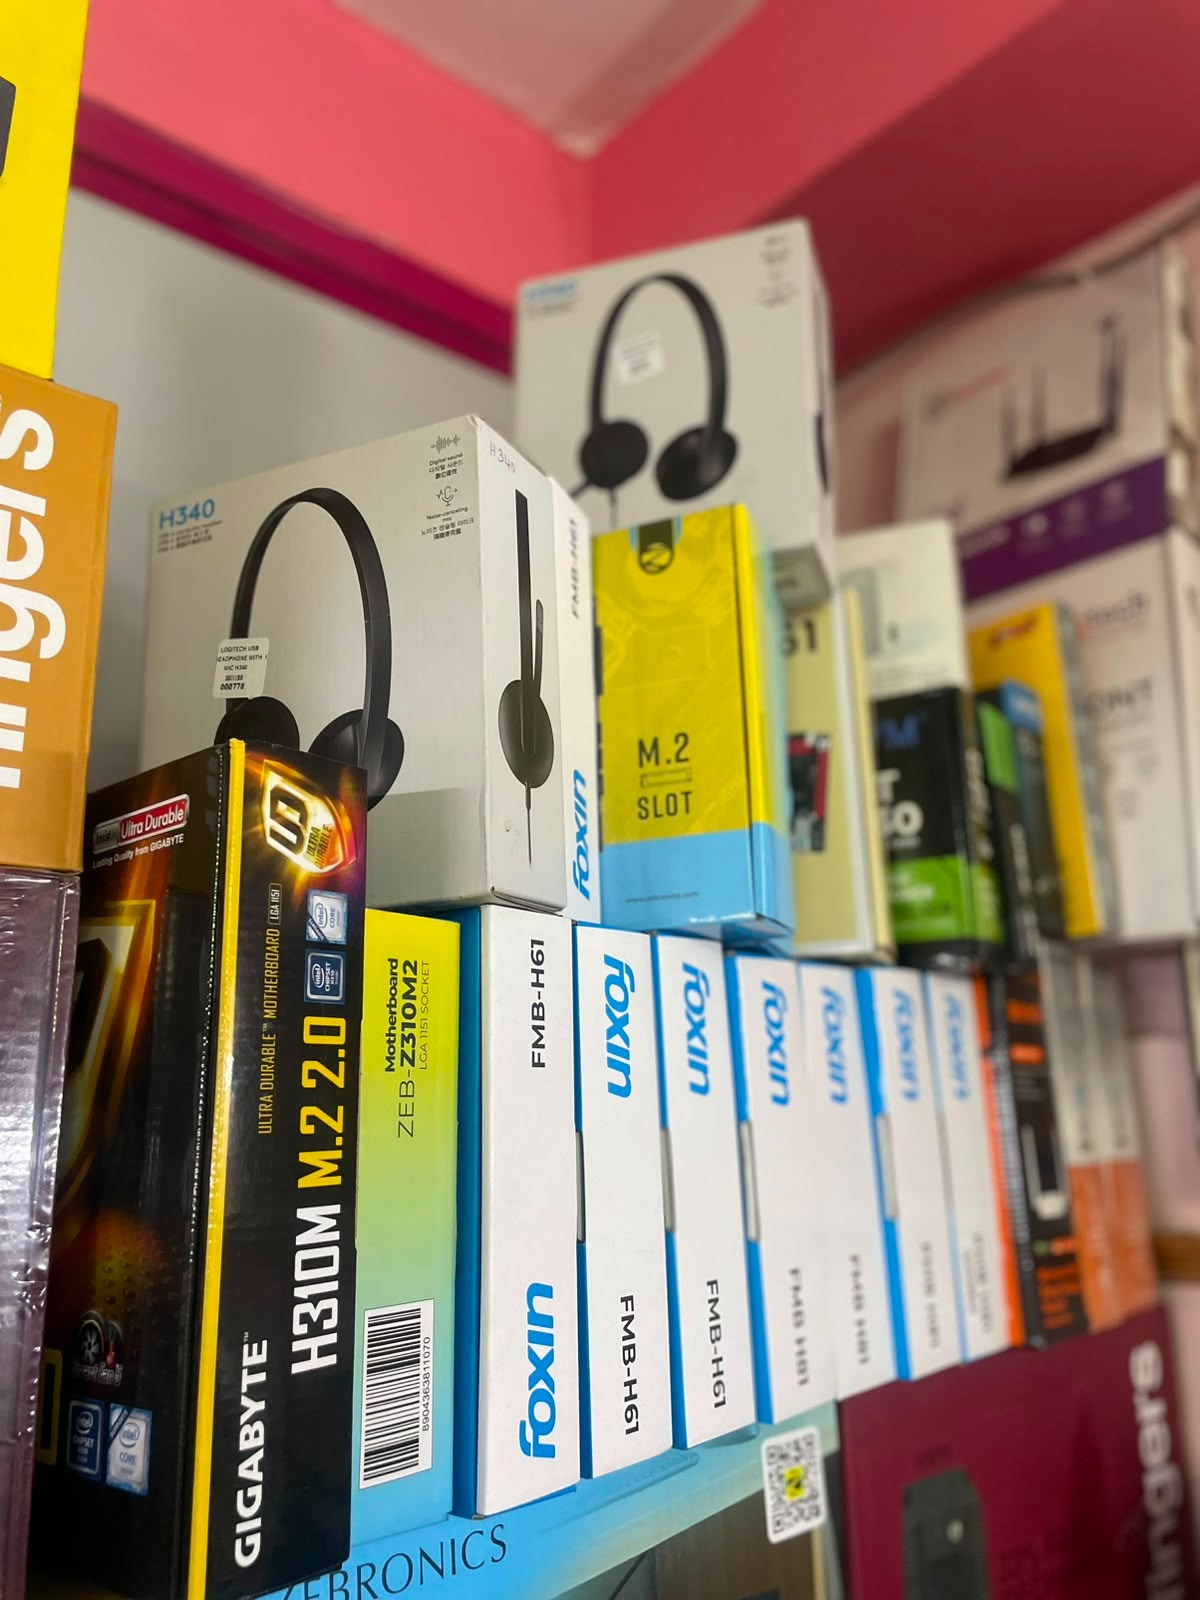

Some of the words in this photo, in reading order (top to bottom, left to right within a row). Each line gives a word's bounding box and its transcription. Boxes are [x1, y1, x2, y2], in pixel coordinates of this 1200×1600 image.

[159, 499, 215, 530] H340
[638, 733, 690, 768] M.2
[121, 820, 143, 839] Ultra
[145, 805, 184, 832] Durable
[305, 825, 321, 858] ULTRA
[572, 769, 590, 901] foxin
[637, 791, 692, 820] SLOT
[113, 849, 134, 863] Quality
[135, 846, 149, 857] from
[150, 833, 184, 851] GIGABYTE
[314, 823, 334, 869] DURABLE
[270, 904, 280, 920] LGA
[328, 907, 336, 928] CORE
[263, 928, 281, 1019] MOTHERBOARD
[421, 960, 430, 1014] SOCKET
[530, 938, 546, 1069] FMB-H61
[384, 957, 399, 1072] Motherboard
[398, 959, 418, 1138] ZEB-Z310M2
[420, 1018, 429, 1034] 1151
[603, 953, 636, 1098] foxin
[681, 961, 710, 1097] foxin
[761, 980, 790, 1107] foxin
[301, 1016, 347, 1089] 2.0
[419, 1042, 428, 1070] LGA
[258, 1094, 274, 1134] ULTRA
[297, 1105, 344, 1189] M.2
[291, 1203, 341, 1375] H310M
[519, 1281, 557, 1460] foxin
[619, 1294, 640, 1435] FMB-H61
[705, 1279, 725, 1409] FMB-H61
[421, 1336, 431, 1432] 8904363811070
[119, 1451, 137, 1465] CORE
